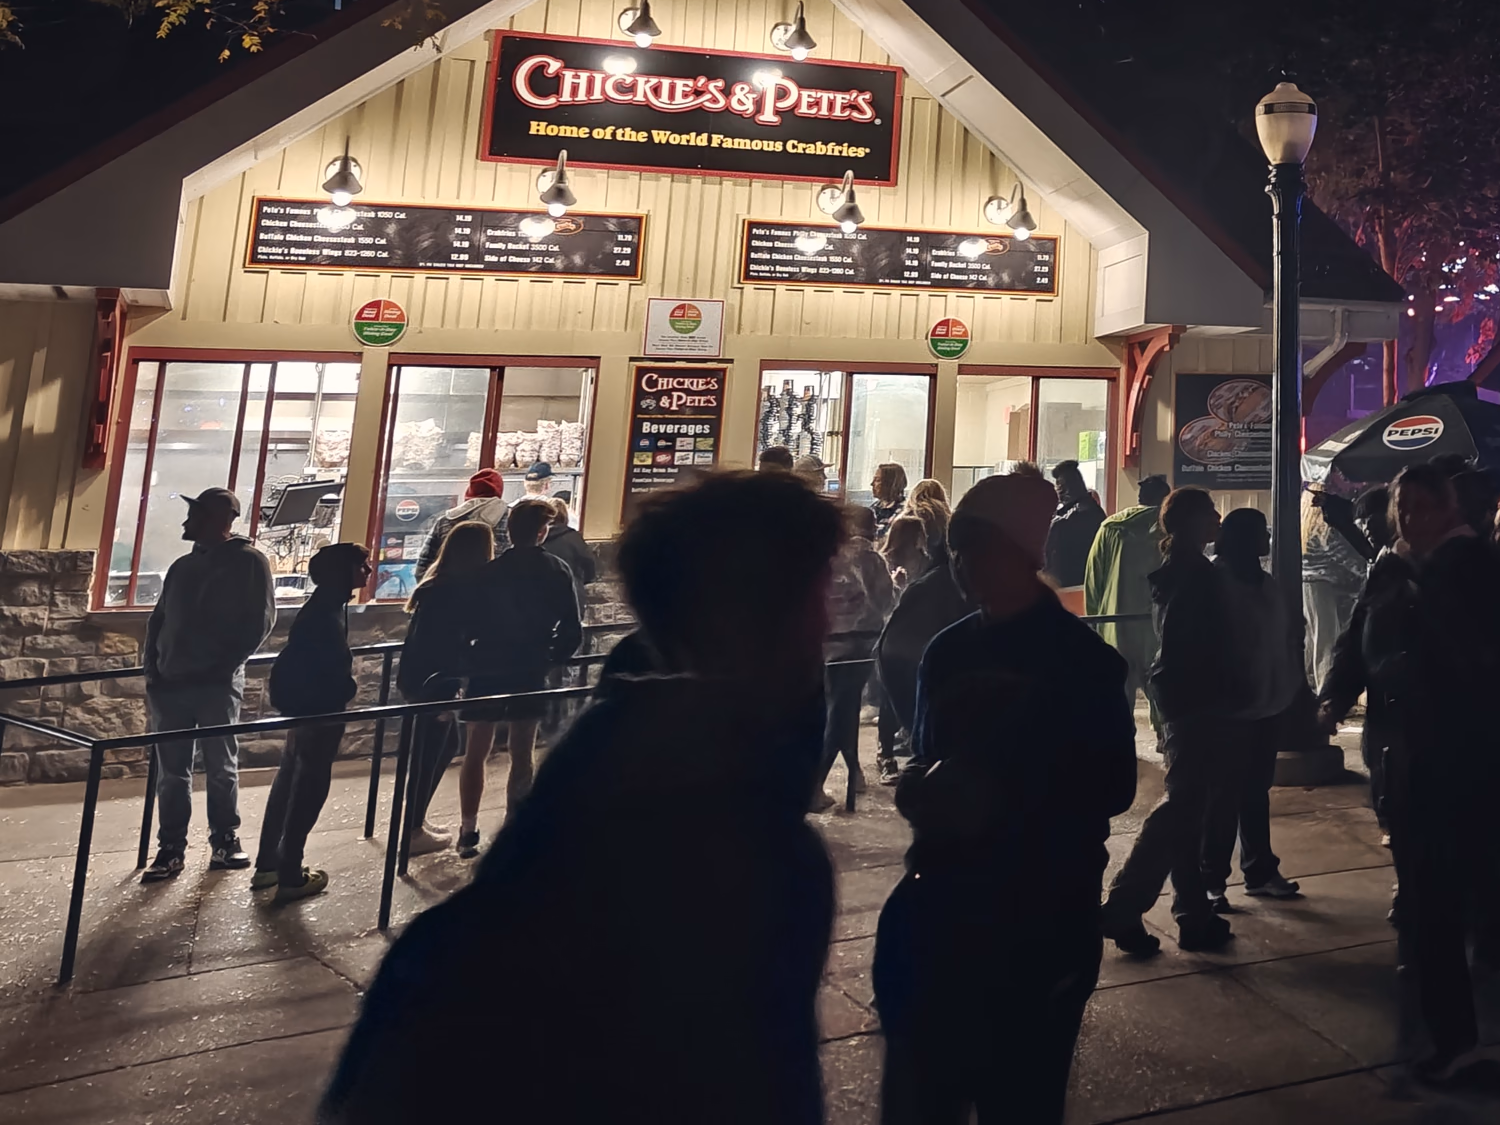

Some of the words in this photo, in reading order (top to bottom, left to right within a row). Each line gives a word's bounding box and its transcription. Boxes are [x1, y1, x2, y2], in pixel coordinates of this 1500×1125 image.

[512, 54, 727, 113] CHICKIE'S
[729, 82, 757, 117] &
[755, 75, 876, 125] PETE'S
[529, 121, 590, 137] Home
[591, 126, 615, 140] of
[615, 127, 648, 143] the
[651, 129, 708, 147] World
[710, 134, 783, 152] Famous
[786, 140, 867, 158] Crabfries
[641, 373, 718, 393] CHICKIE'S
[659, 396, 671, 408] &
[670, 391, 717, 410] PETE'S
[642, 422, 710, 435] Beverages
[1387, 427, 1440, 437] PEPSI
